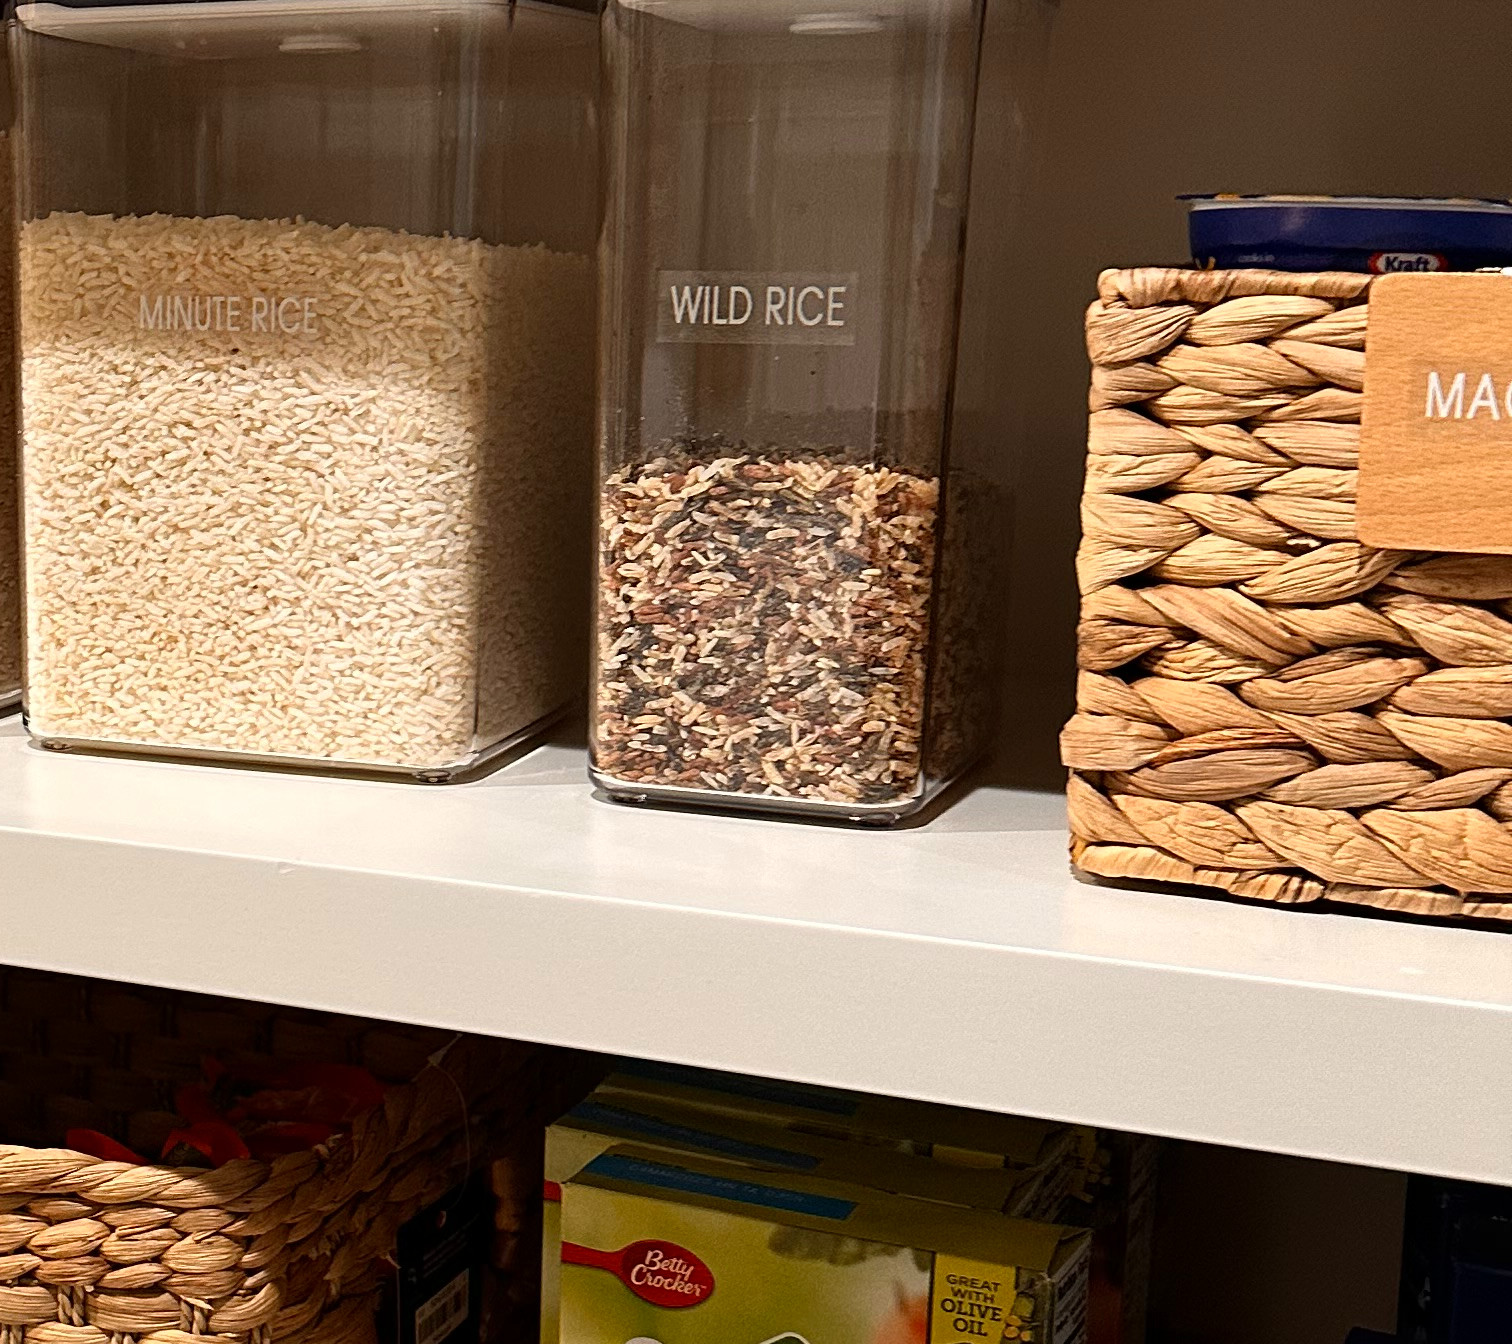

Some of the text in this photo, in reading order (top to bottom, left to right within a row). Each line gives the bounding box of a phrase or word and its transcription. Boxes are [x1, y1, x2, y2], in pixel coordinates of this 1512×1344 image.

[138, 294, 319, 336] MINUTE RICE
[670, 285, 847, 328] WILD RICE
[1424, 371, 1512, 421] MA
[630, 1263, 702, 1297] Crocker
[644, 1249, 695, 1282] Betty
[945, 1273, 1001, 1293] GREAT
[950, 1286, 995, 1305] WITH
[940, 1297, 1003, 1322] OLIVE
[952, 1317, 988, 1337] OIL
